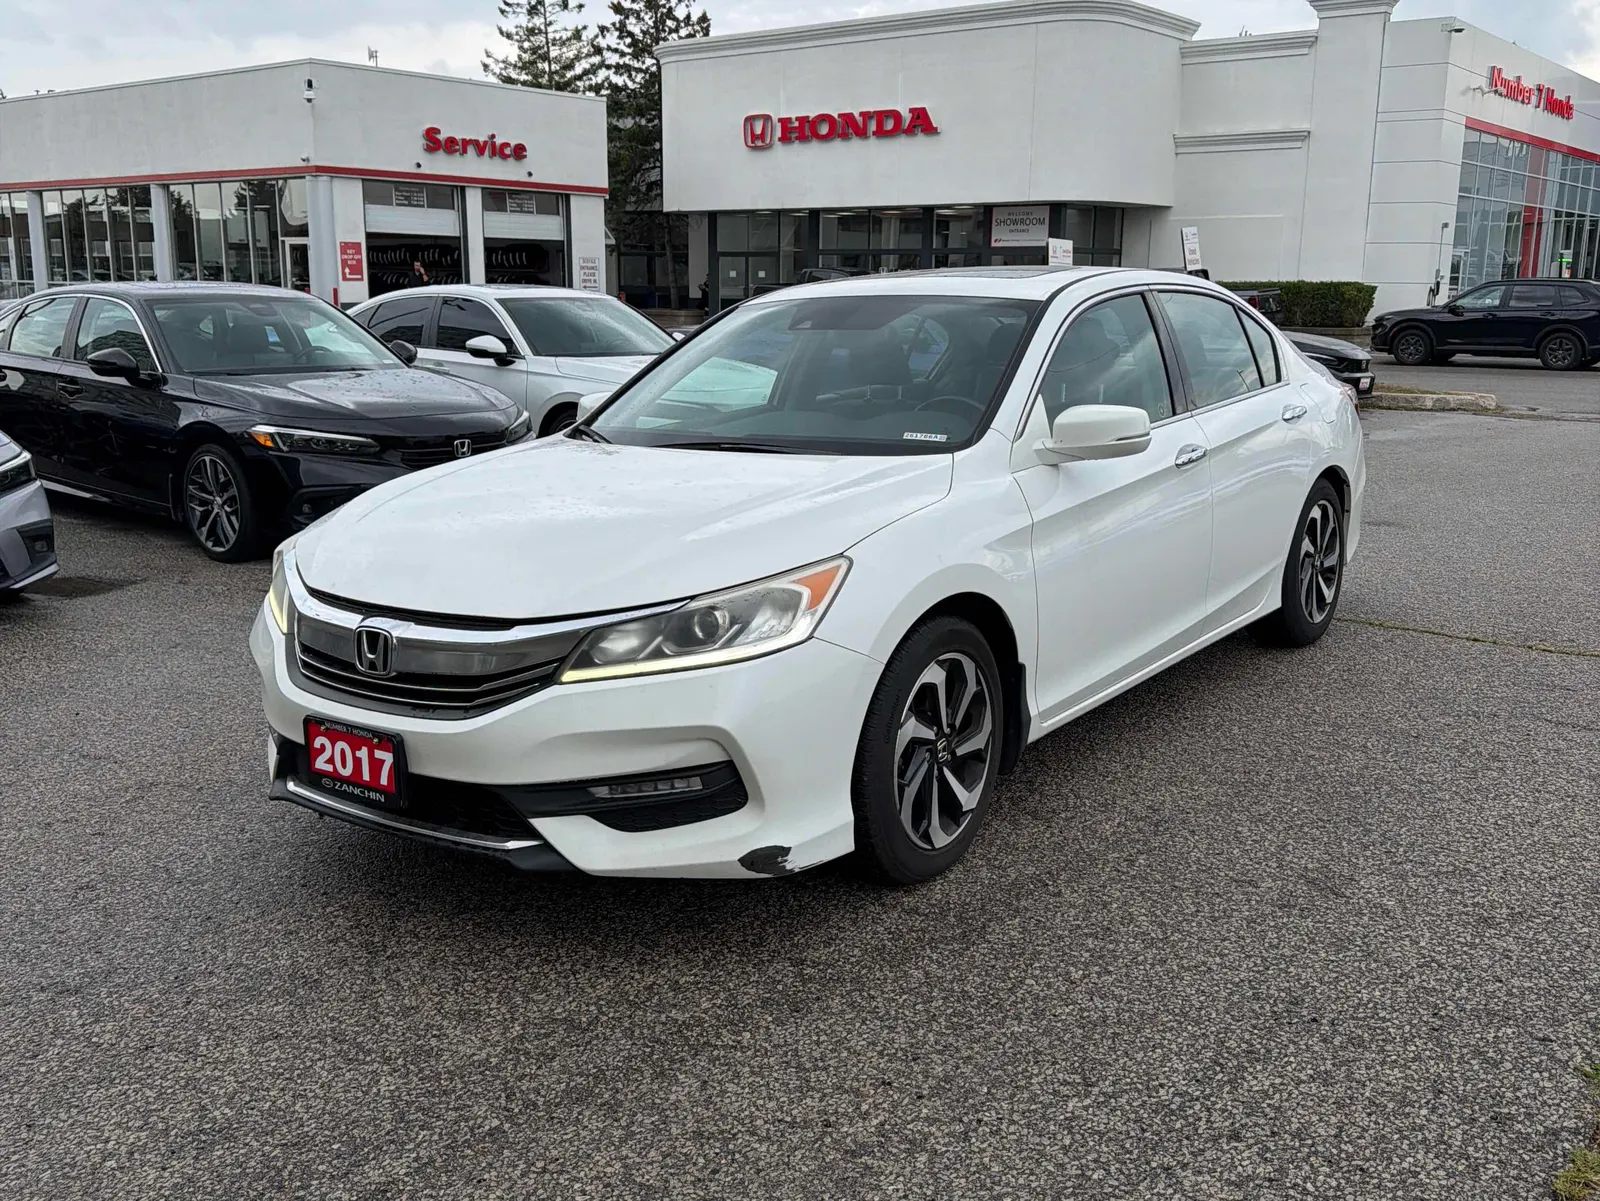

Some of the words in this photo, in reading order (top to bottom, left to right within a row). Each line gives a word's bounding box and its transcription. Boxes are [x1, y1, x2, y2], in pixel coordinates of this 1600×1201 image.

[1488, 66, 1535, 105] Number
[1535, 83, 1545, 109] 7
[1544, 87, 1575, 120] Honda
[777, 106, 940, 143] HONDA
[423, 126, 528, 161] Service
[994, 217, 1046, 227] SHOWROOM
[324, 720, 348, 733] NUMBER
[351, 727, 374, 740] HONDA
[313, 734, 394, 787] 2017
[334, 780, 385, 803] ZANCHIN
